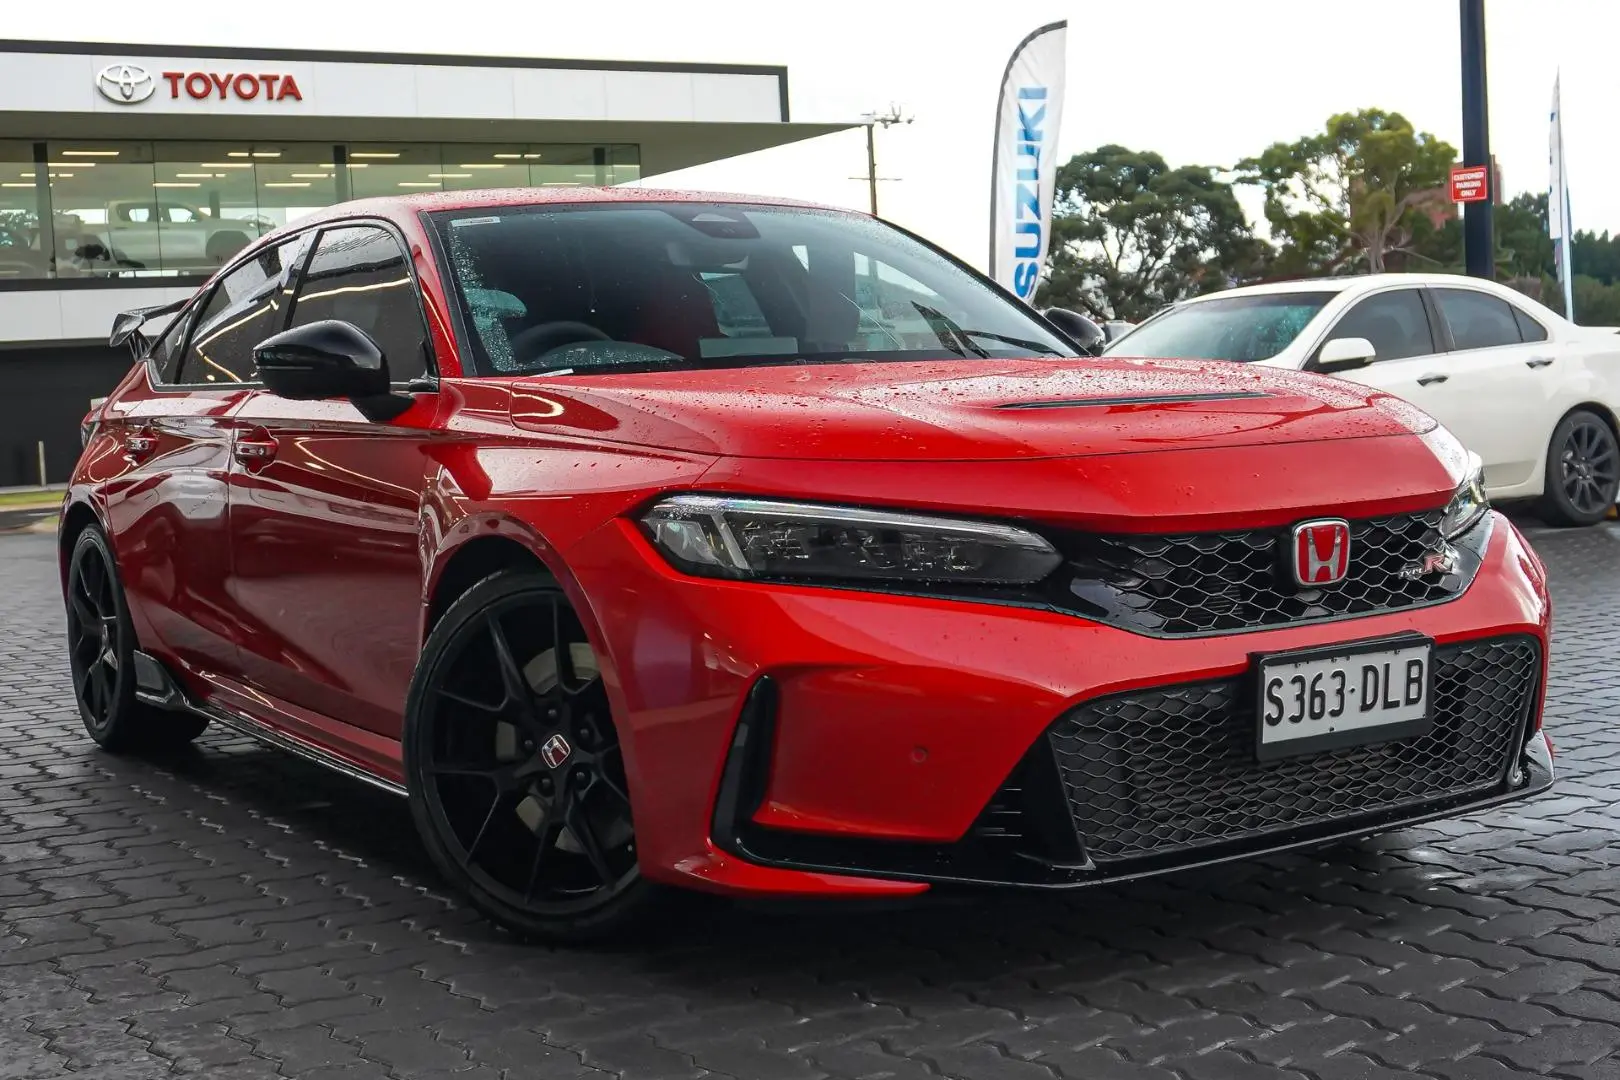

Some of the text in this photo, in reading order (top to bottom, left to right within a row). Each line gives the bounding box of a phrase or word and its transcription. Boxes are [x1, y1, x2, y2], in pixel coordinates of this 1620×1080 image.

[162, 71, 303, 101] TOYOTA
[1014, 86, 1048, 299] SUZUKI
[1461, 189, 1477, 197] ONLY
